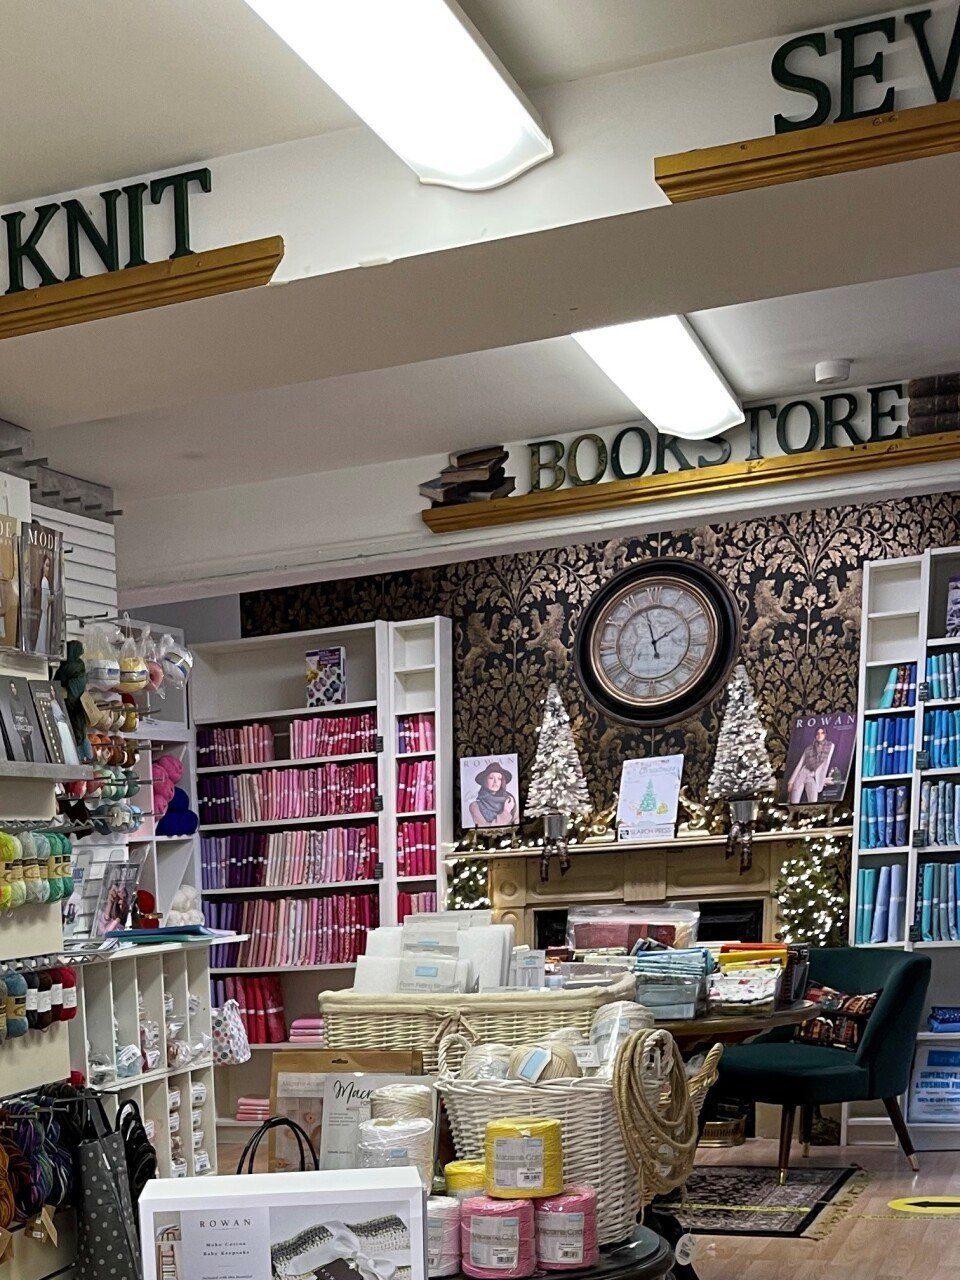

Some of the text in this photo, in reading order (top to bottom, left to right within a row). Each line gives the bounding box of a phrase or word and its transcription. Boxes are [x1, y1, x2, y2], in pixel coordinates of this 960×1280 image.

[0, 167, 211, 294] KNIT
[796, 714, 856, 728] ROWAN
[463, 757, 514, 768] ROWAN
[333, 1080, 372, 1104] Macr
[199, 1218, 251, 1228] ROWAN
